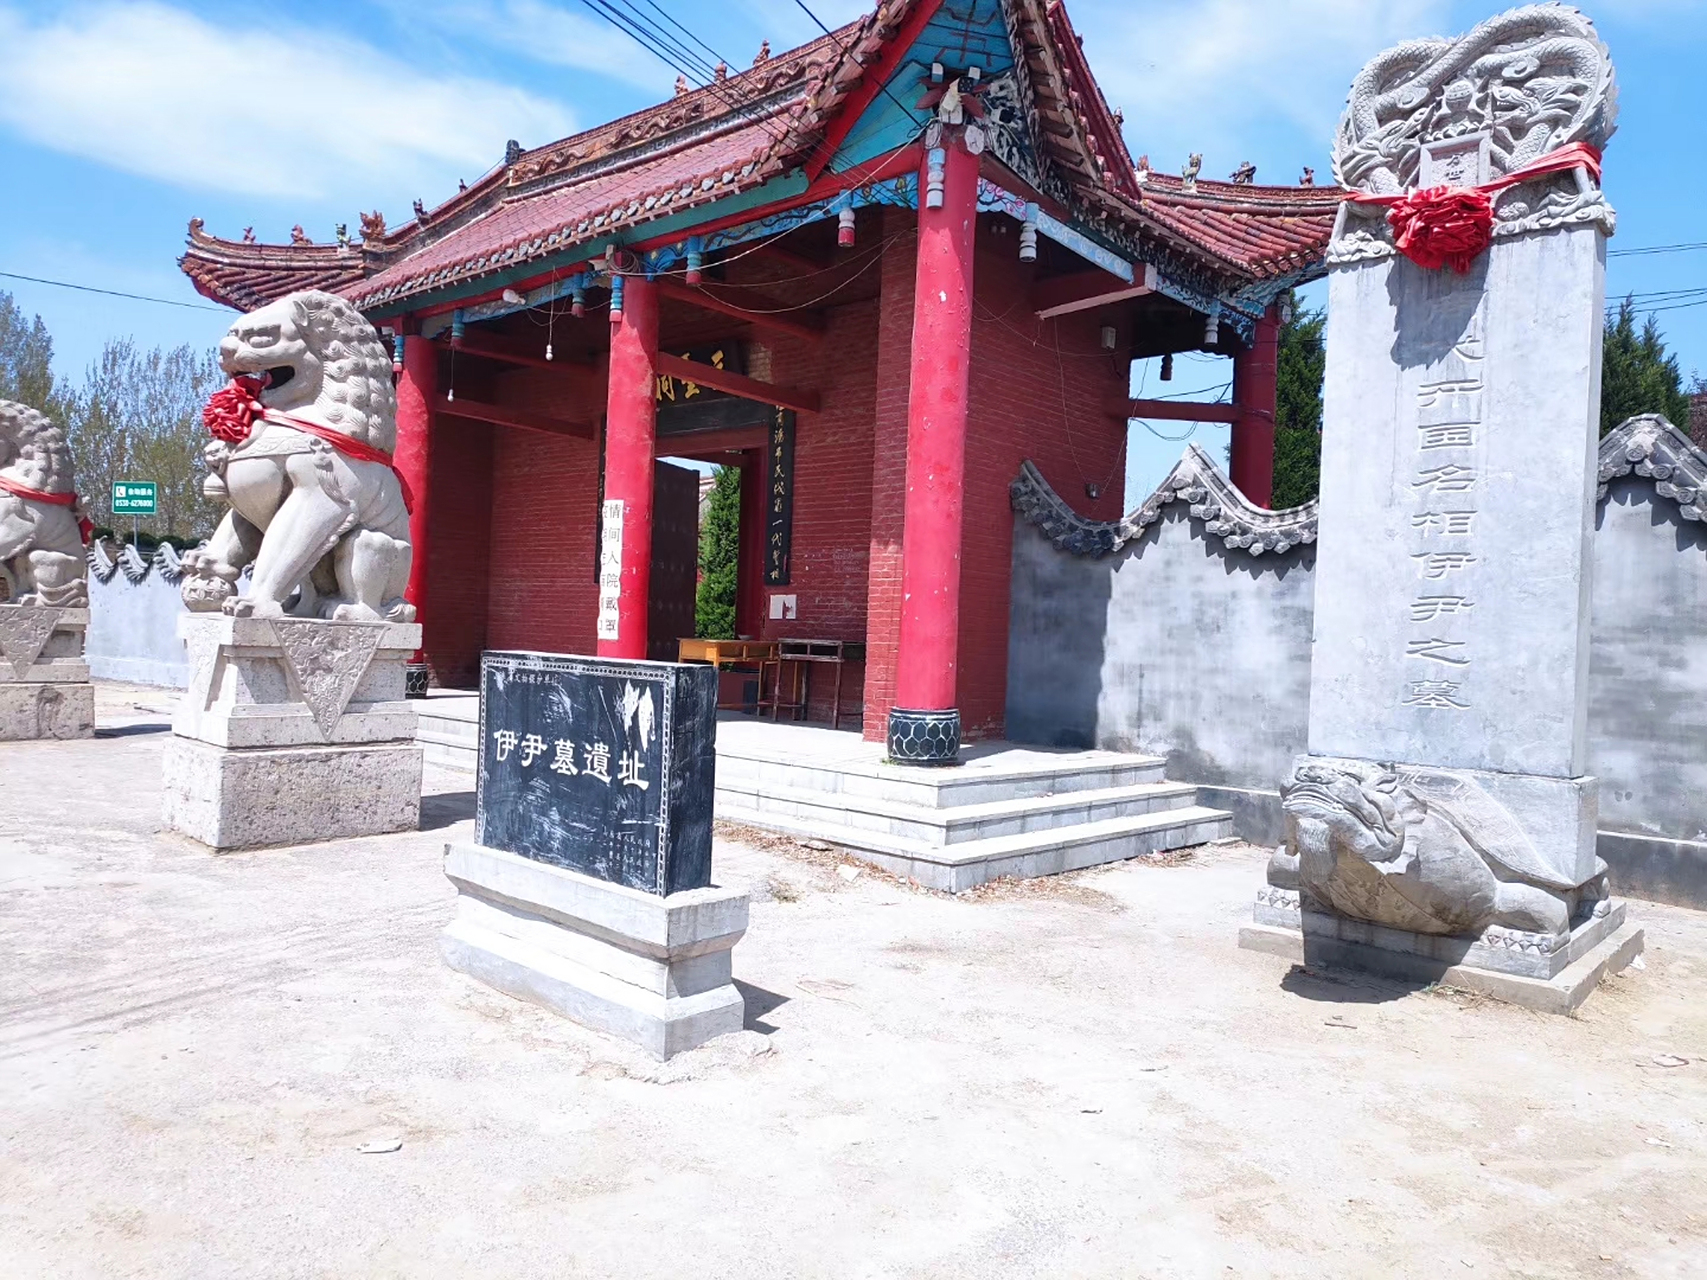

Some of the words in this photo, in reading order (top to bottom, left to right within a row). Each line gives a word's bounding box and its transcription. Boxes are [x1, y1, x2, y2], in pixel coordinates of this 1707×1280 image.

[493, 729, 650, 791] 伊尹墓遺址
